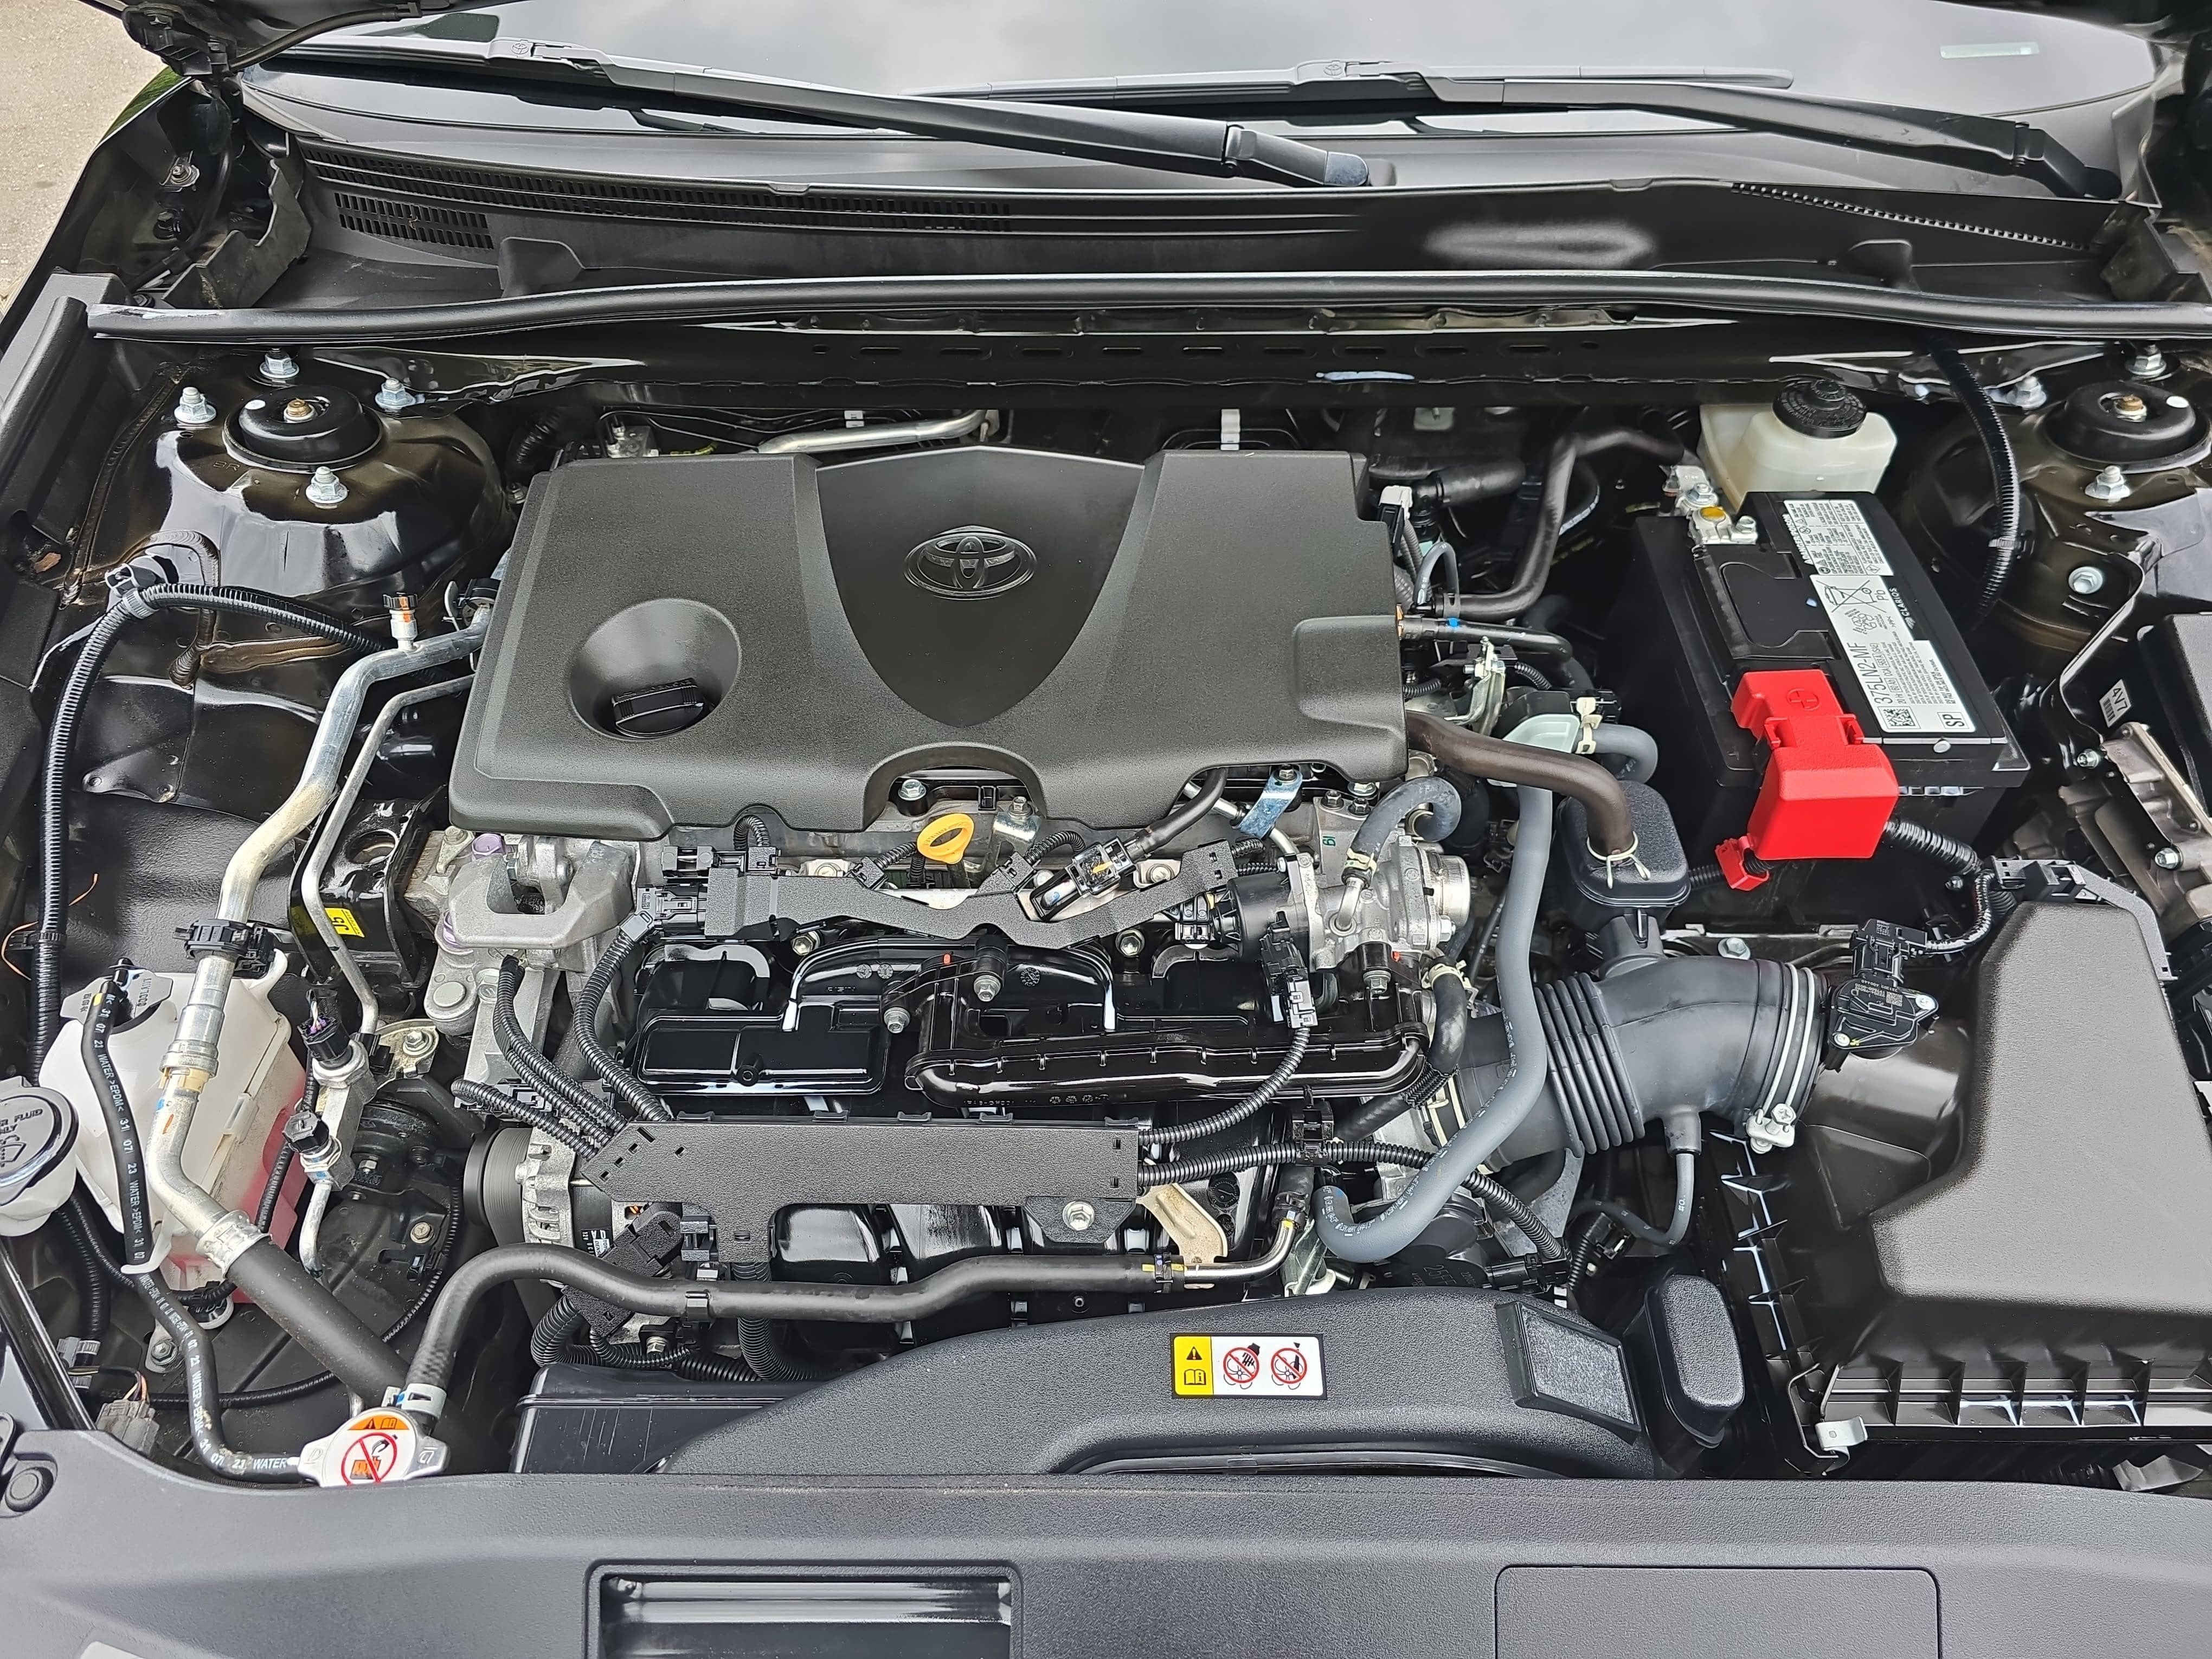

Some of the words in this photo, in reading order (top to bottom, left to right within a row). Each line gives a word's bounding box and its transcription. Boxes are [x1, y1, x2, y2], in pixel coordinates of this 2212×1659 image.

[1875, 590, 1889, 601] Pb
[1889, 587, 1910, 616] CLARIOS
[1847, 642, 1893, 704] 375LN2-MF
[2112, 687, 2128, 711] 4V7
[1942, 713, 1965, 727] SP
[332, 917, 349, 930] J5
[98, 1053, 115, 1079] WATER
[14, 1109, 43, 1123] FLUID
[127, 1163, 137, 1175] 23
[130, 1180, 139, 1208] WATER
[192, 1370, 202, 1403] WATER
[253, 1458, 287, 1469] WATER
